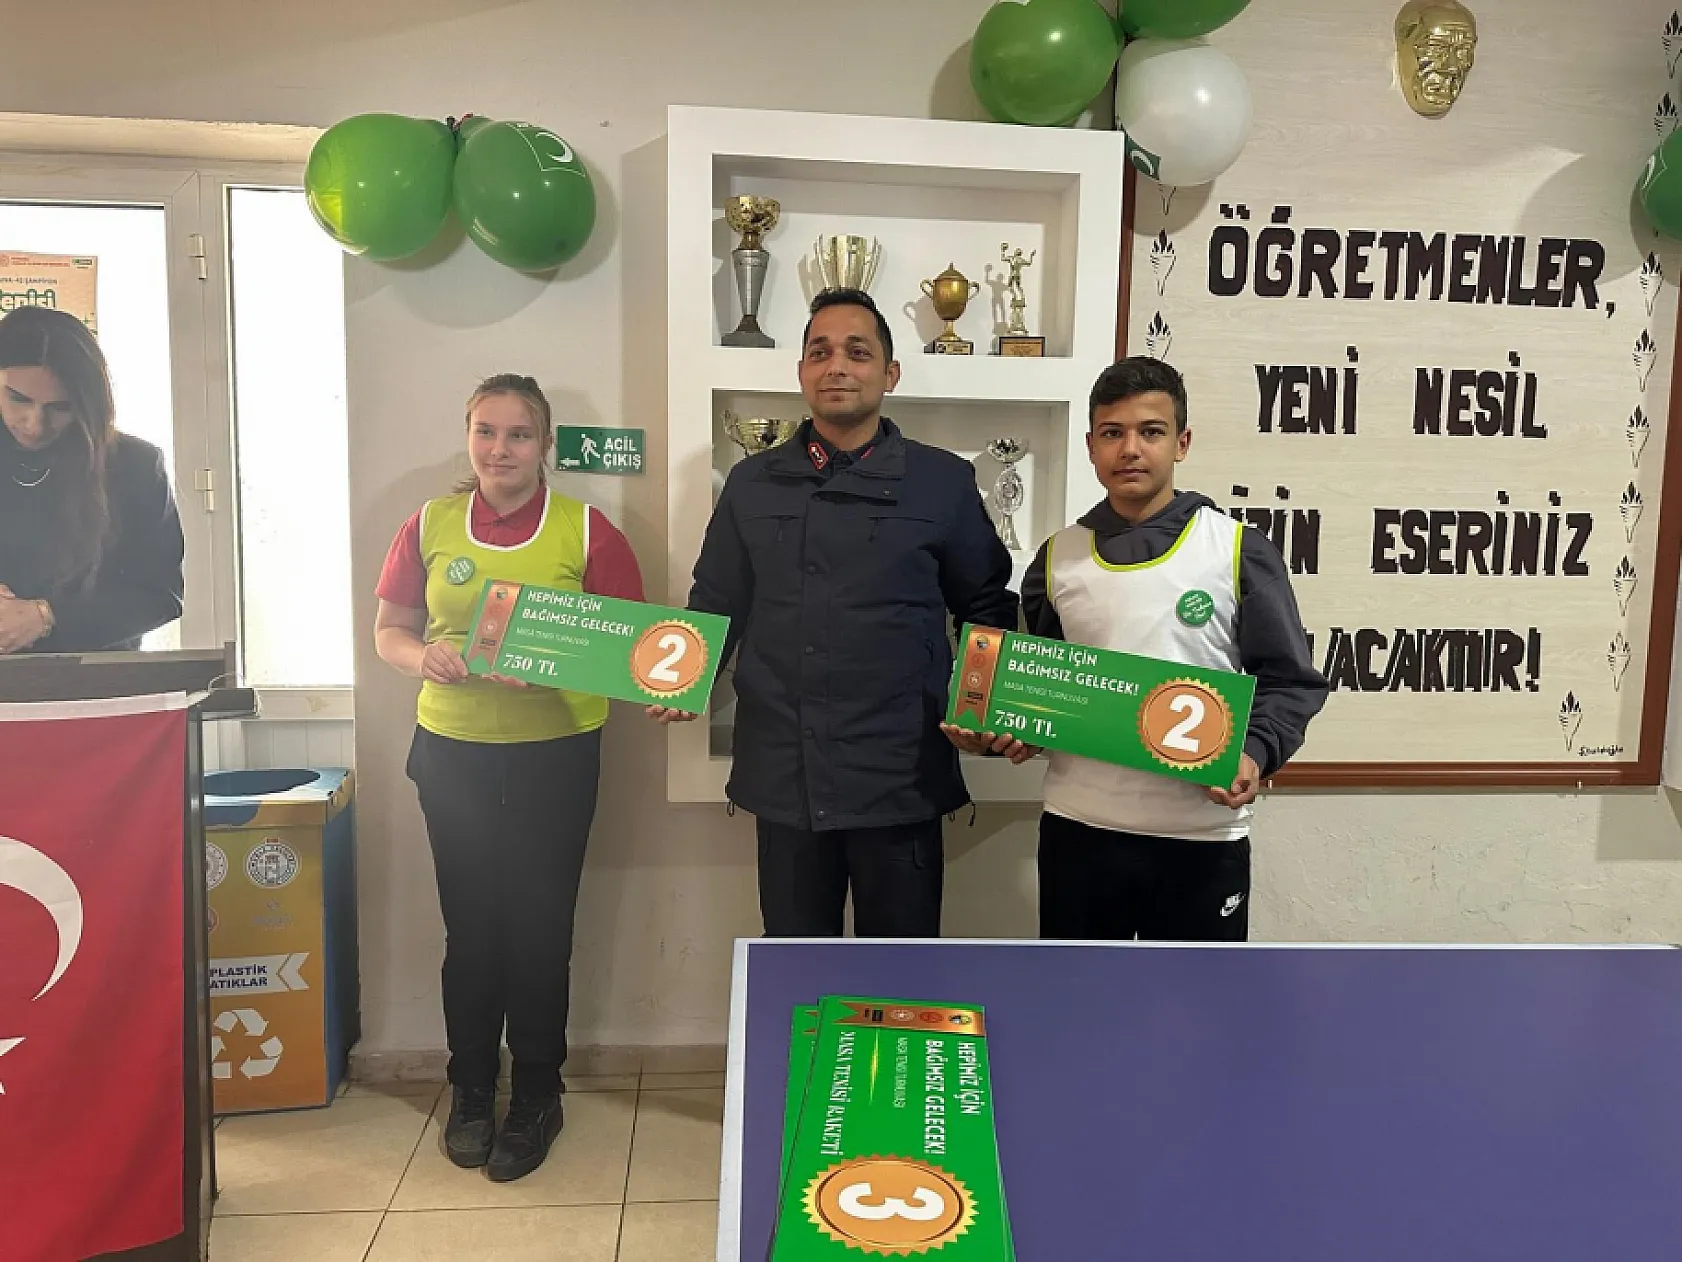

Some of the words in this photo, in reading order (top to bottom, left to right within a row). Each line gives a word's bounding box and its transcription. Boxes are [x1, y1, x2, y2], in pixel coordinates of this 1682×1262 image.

[1208, 204, 1616, 318] ÖĞRETMENLER,
[1255, 346, 1359, 434] YENİ
[1413, 351, 1547, 438] NESİL
[1371, 490, 1593, 576] ESERİNİZ
[522, 607, 578, 626] BAĞIMSIZ
[581, 617, 635, 637] GELECEK!
[528, 590, 574, 608] HEPİMİZ
[576, 596, 602, 613] İÇİN
[538, 660, 558, 676] TL
[648, 634, 686, 683] 2
[1011, 639, 1065, 660] HEPİMİZ
[1068, 647, 1098, 668] İÇİN
[1007, 659, 1072, 682] BAĞIMSIZ
[1075, 672, 1140, 696] GELECEK!
[1032, 717, 1057, 738] TL
[1160, 694, 1204, 753] 2
[925, 1039, 948, 1092] BAĞIMSIZ
[957, 1041, 983, 1087] HEPİMİZ
[953, 1087, 985, 1115] İÇİN
[924, 1094, 946, 1155] GELECEK!
[838, 1182, 945, 1221] 3
